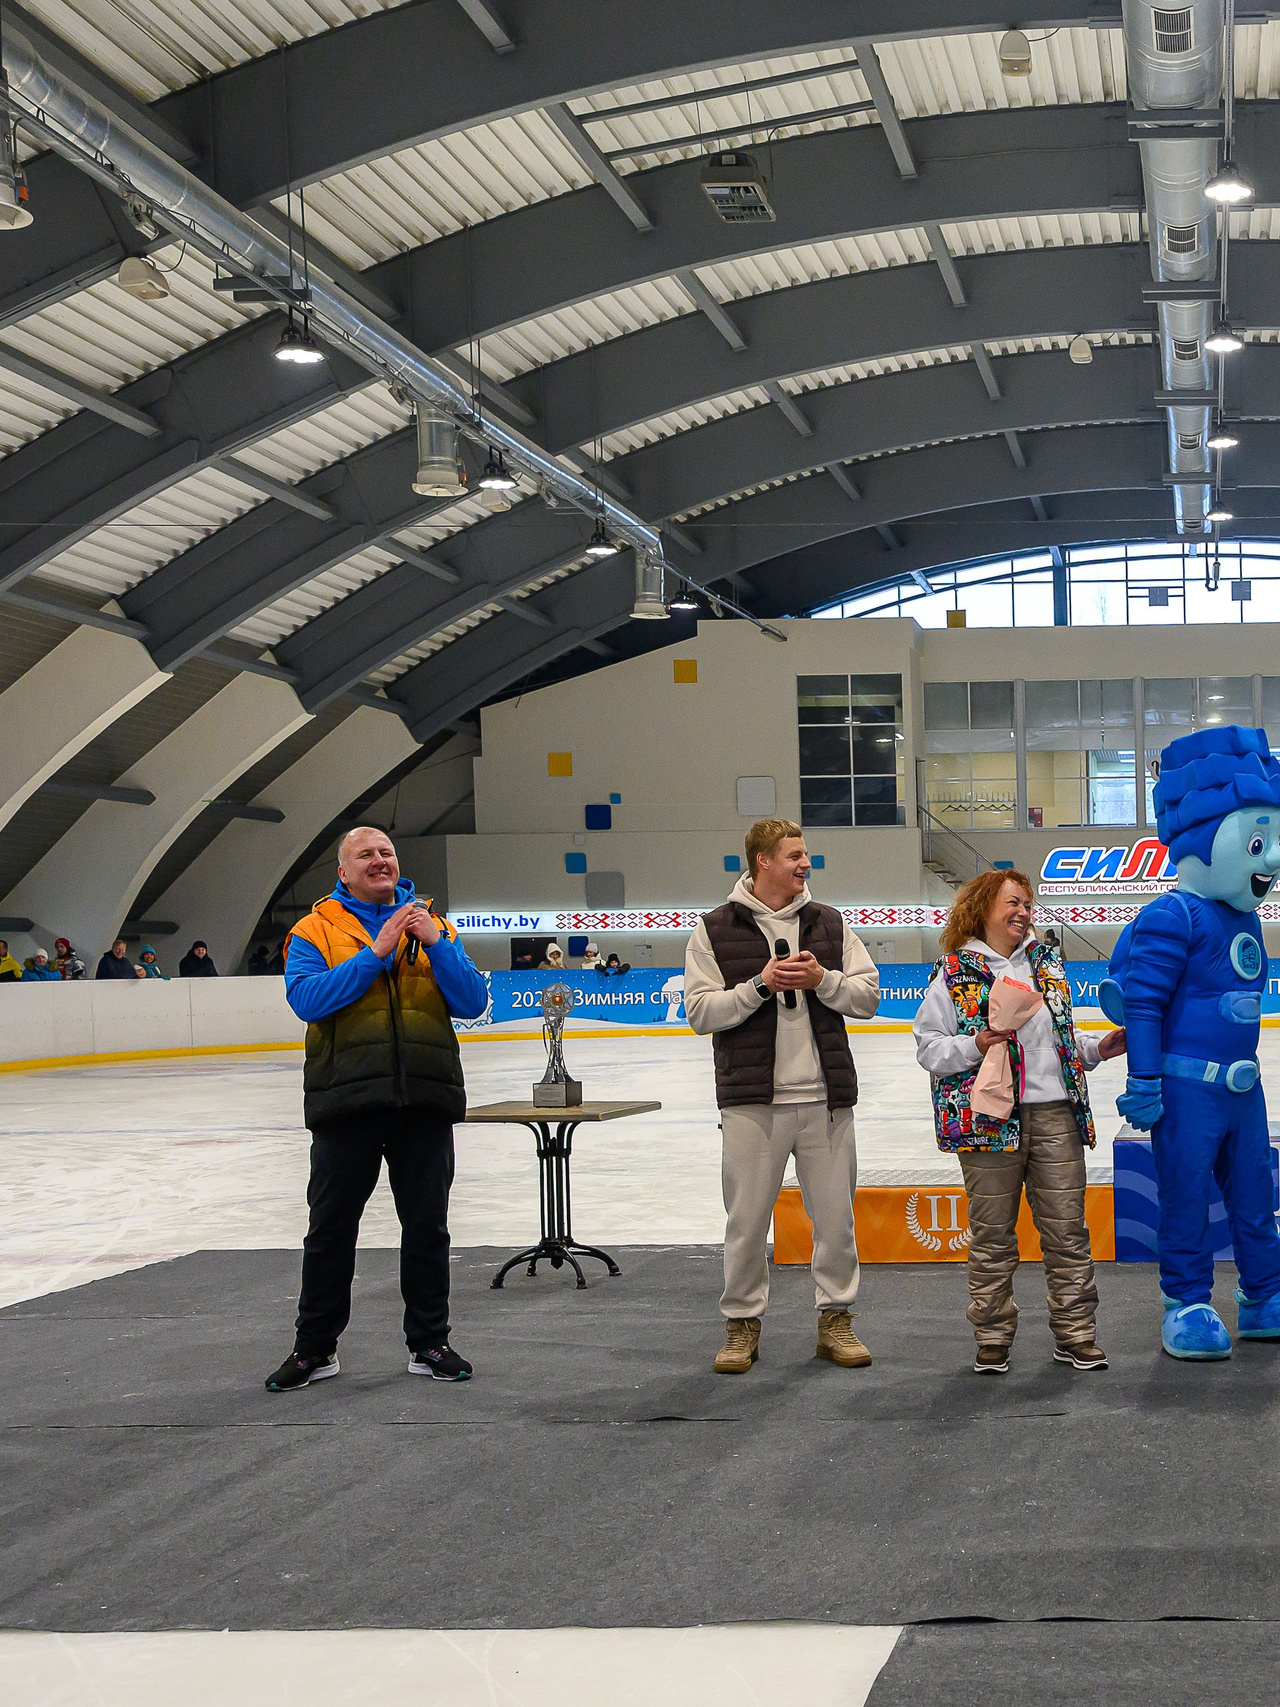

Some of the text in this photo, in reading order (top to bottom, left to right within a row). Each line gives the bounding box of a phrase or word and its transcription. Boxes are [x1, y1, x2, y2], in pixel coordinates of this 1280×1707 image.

[1041, 837, 1178, 881] СИЛ
[1040, 883, 1158, 893] РЕСПУБЛИКАНСКИЙ
[456, 915, 541, 930] silichy.by
[511, 991, 543, 1008] 202
[573, 989, 645, 1006] Зимняя
[650, 990, 683, 1005] спа
[1076, 980, 1099, 998] Уп
[925, 1195, 963, 1231] II
